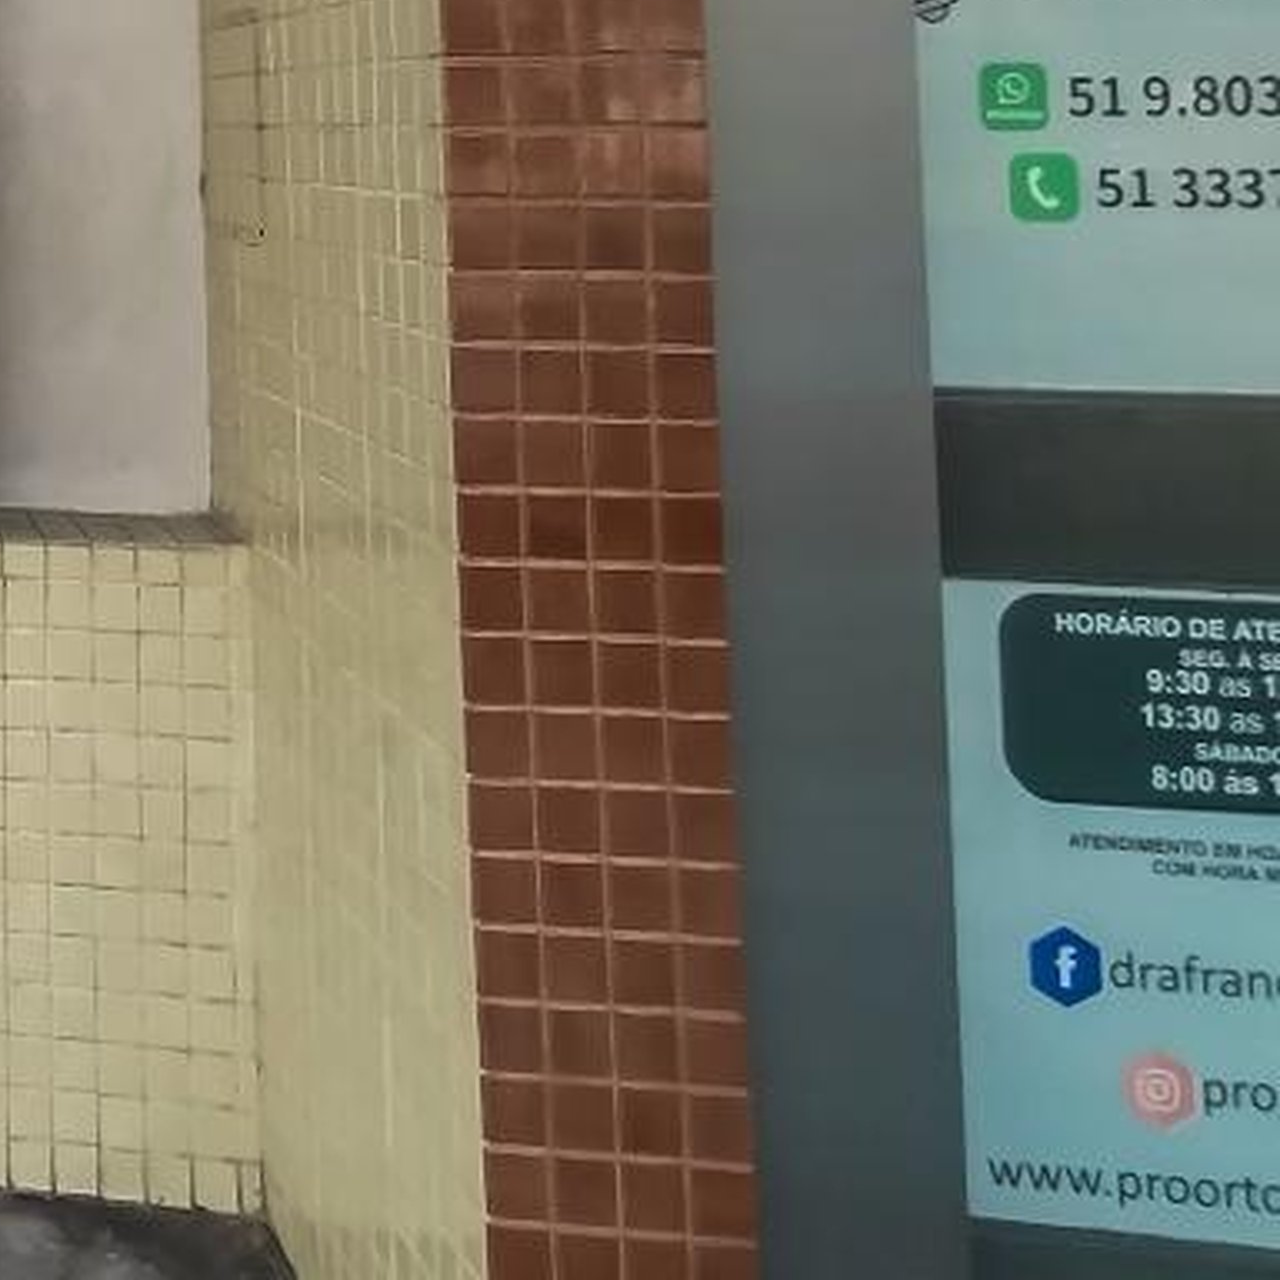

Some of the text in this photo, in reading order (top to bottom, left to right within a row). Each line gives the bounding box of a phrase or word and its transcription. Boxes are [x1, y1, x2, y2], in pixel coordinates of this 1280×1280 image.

[1068, 75, 1280, 117] 51 9.803
[1097, 167, 1155, 208] 51
[1055, 609, 1182, 638] HORÁRIO
[1188, 618, 1227, 640] DE
[1146, 669, 1210, 695] 9:30
[1141, 702, 1220, 732] 13:30
[1152, 765, 1214, 793] 8:00
[1109, 953, 1280, 1000] drafran
[1203, 1078, 1276, 1117] pro
